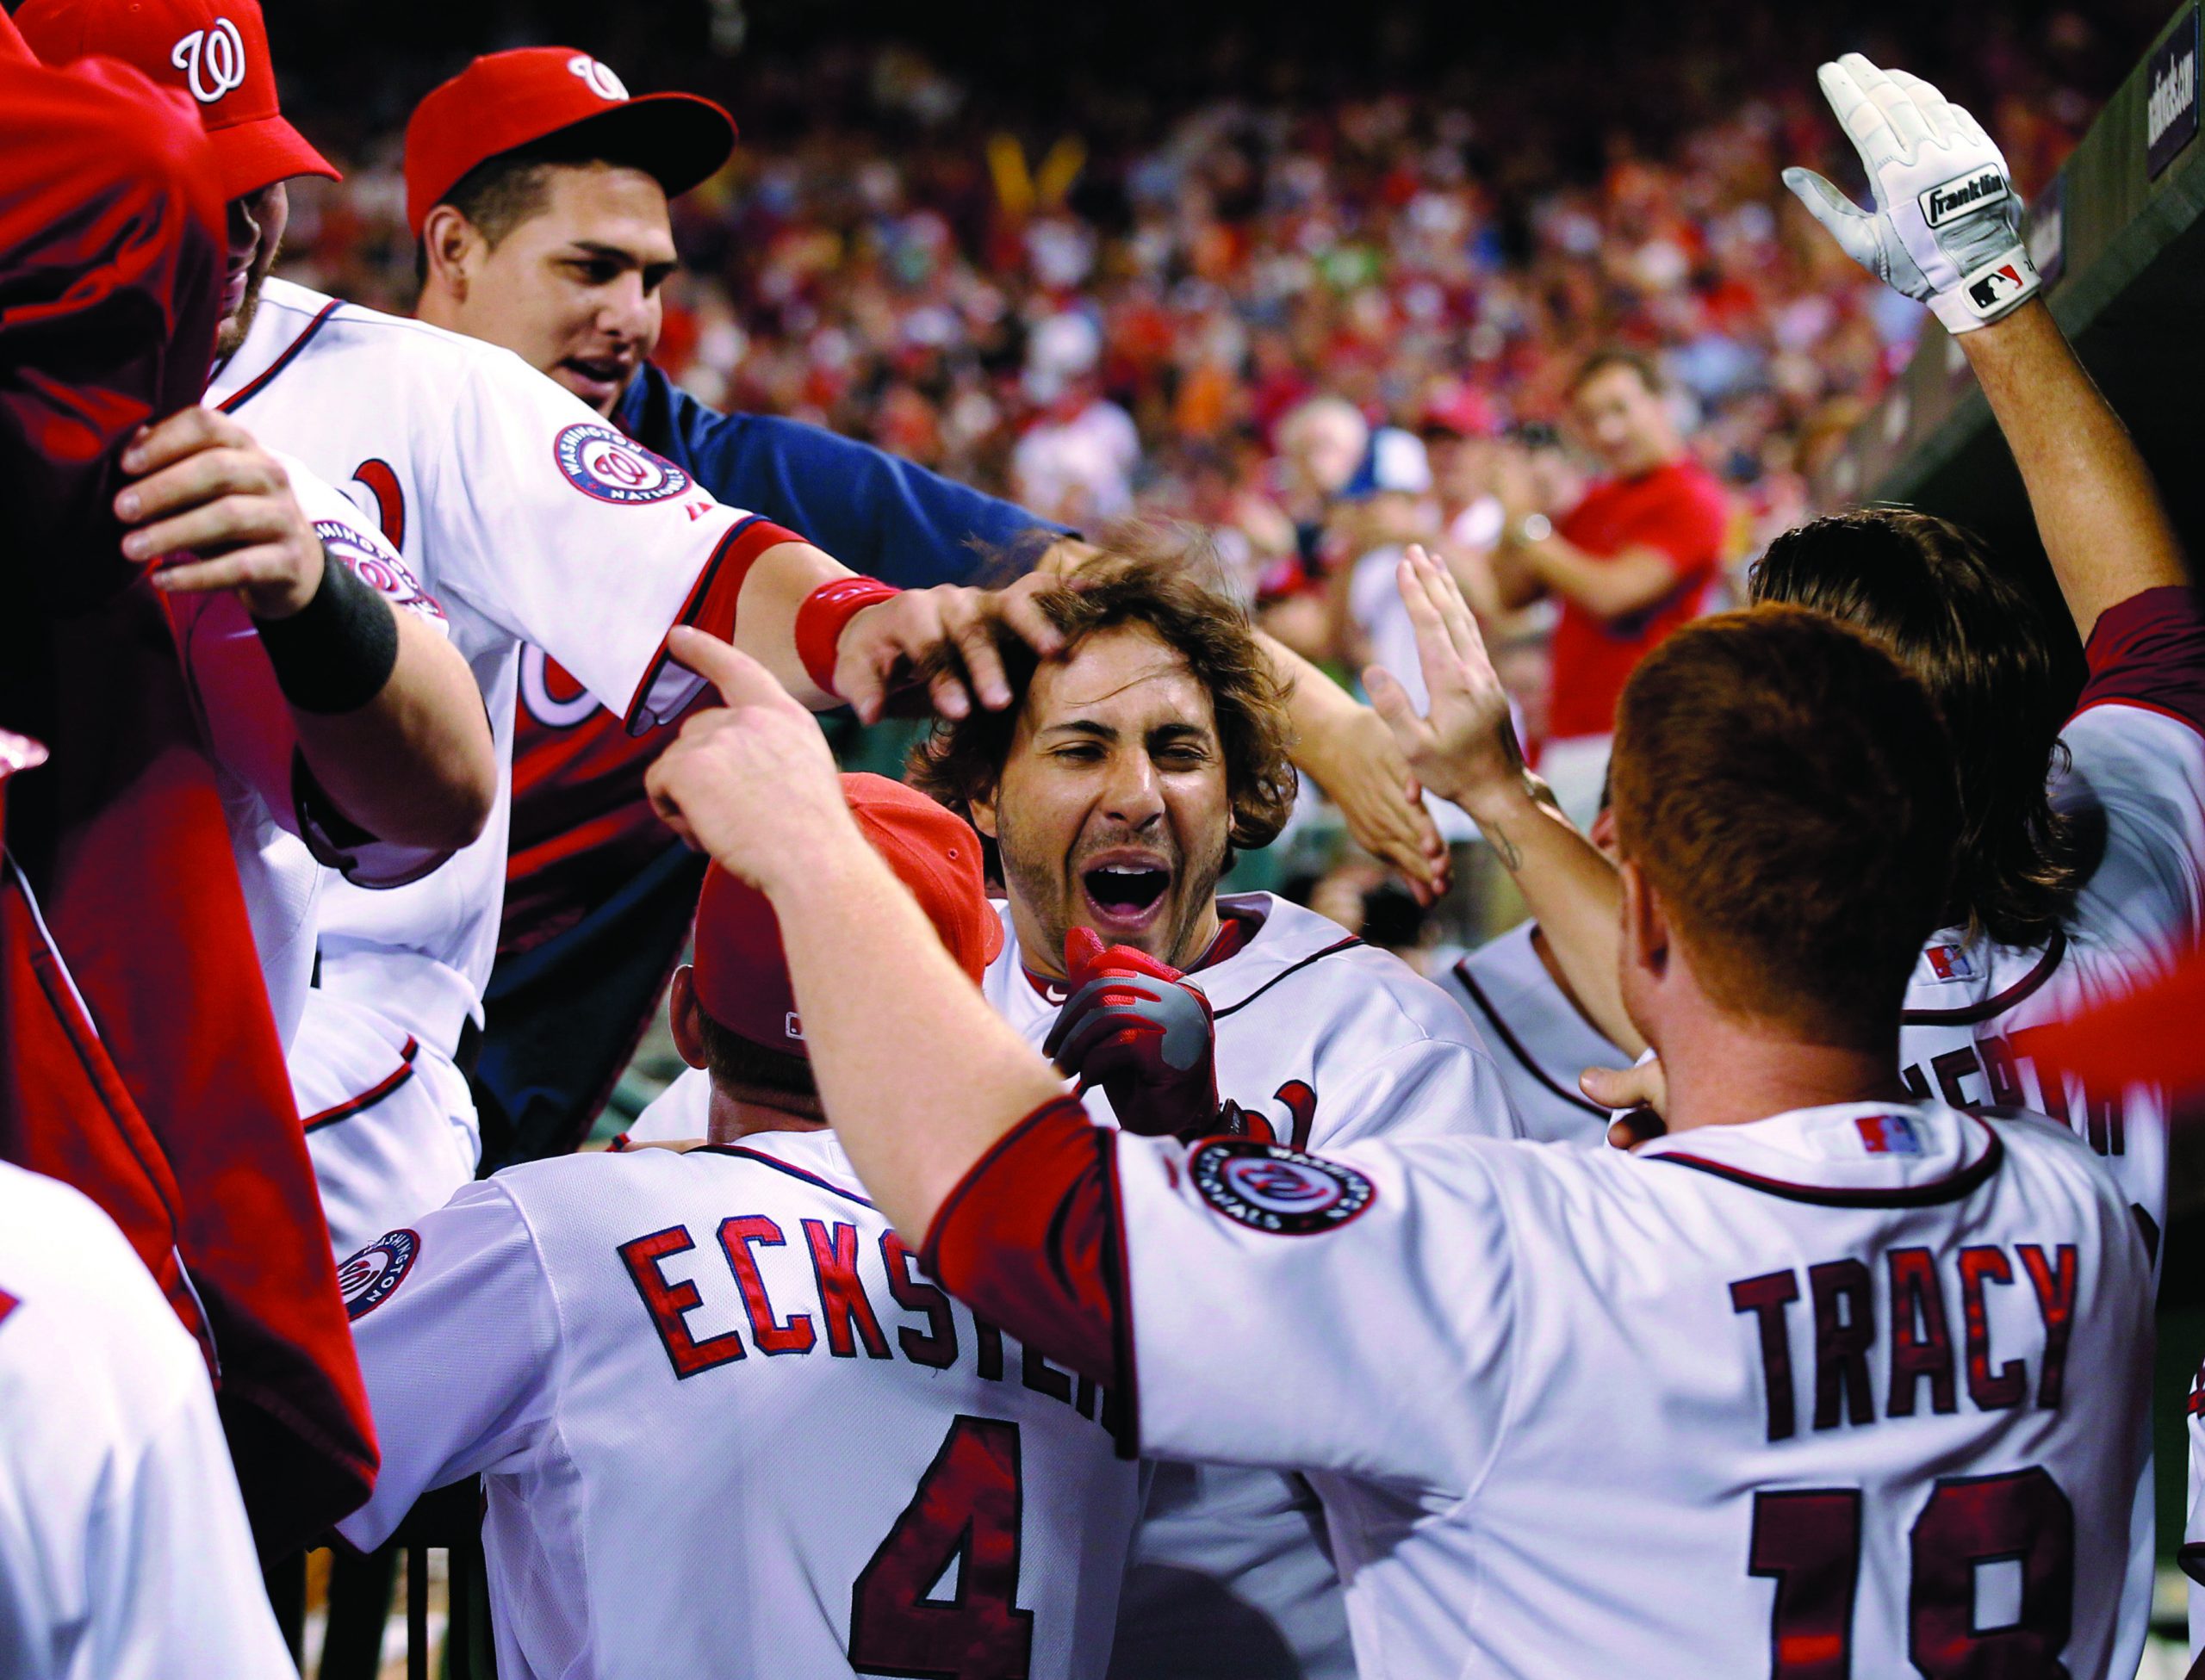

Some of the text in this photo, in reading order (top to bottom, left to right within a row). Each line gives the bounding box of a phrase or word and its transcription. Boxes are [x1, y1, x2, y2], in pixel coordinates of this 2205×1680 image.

[172, 17, 245, 102] W
[1929, 173, 2003, 224] Franklin
[560, 426, 643, 476] WASHINGTON
[610, 468, 686, 501] NATIONALS
[316, 523, 419, 589] HINGTON
[617, 1214, 1117, 1438] ECKS
[1728, 1244, 2078, 1442] TRACY
[848, 1414, 1034, 1680] 4
[1748, 1464, 2075, 1680] 18
